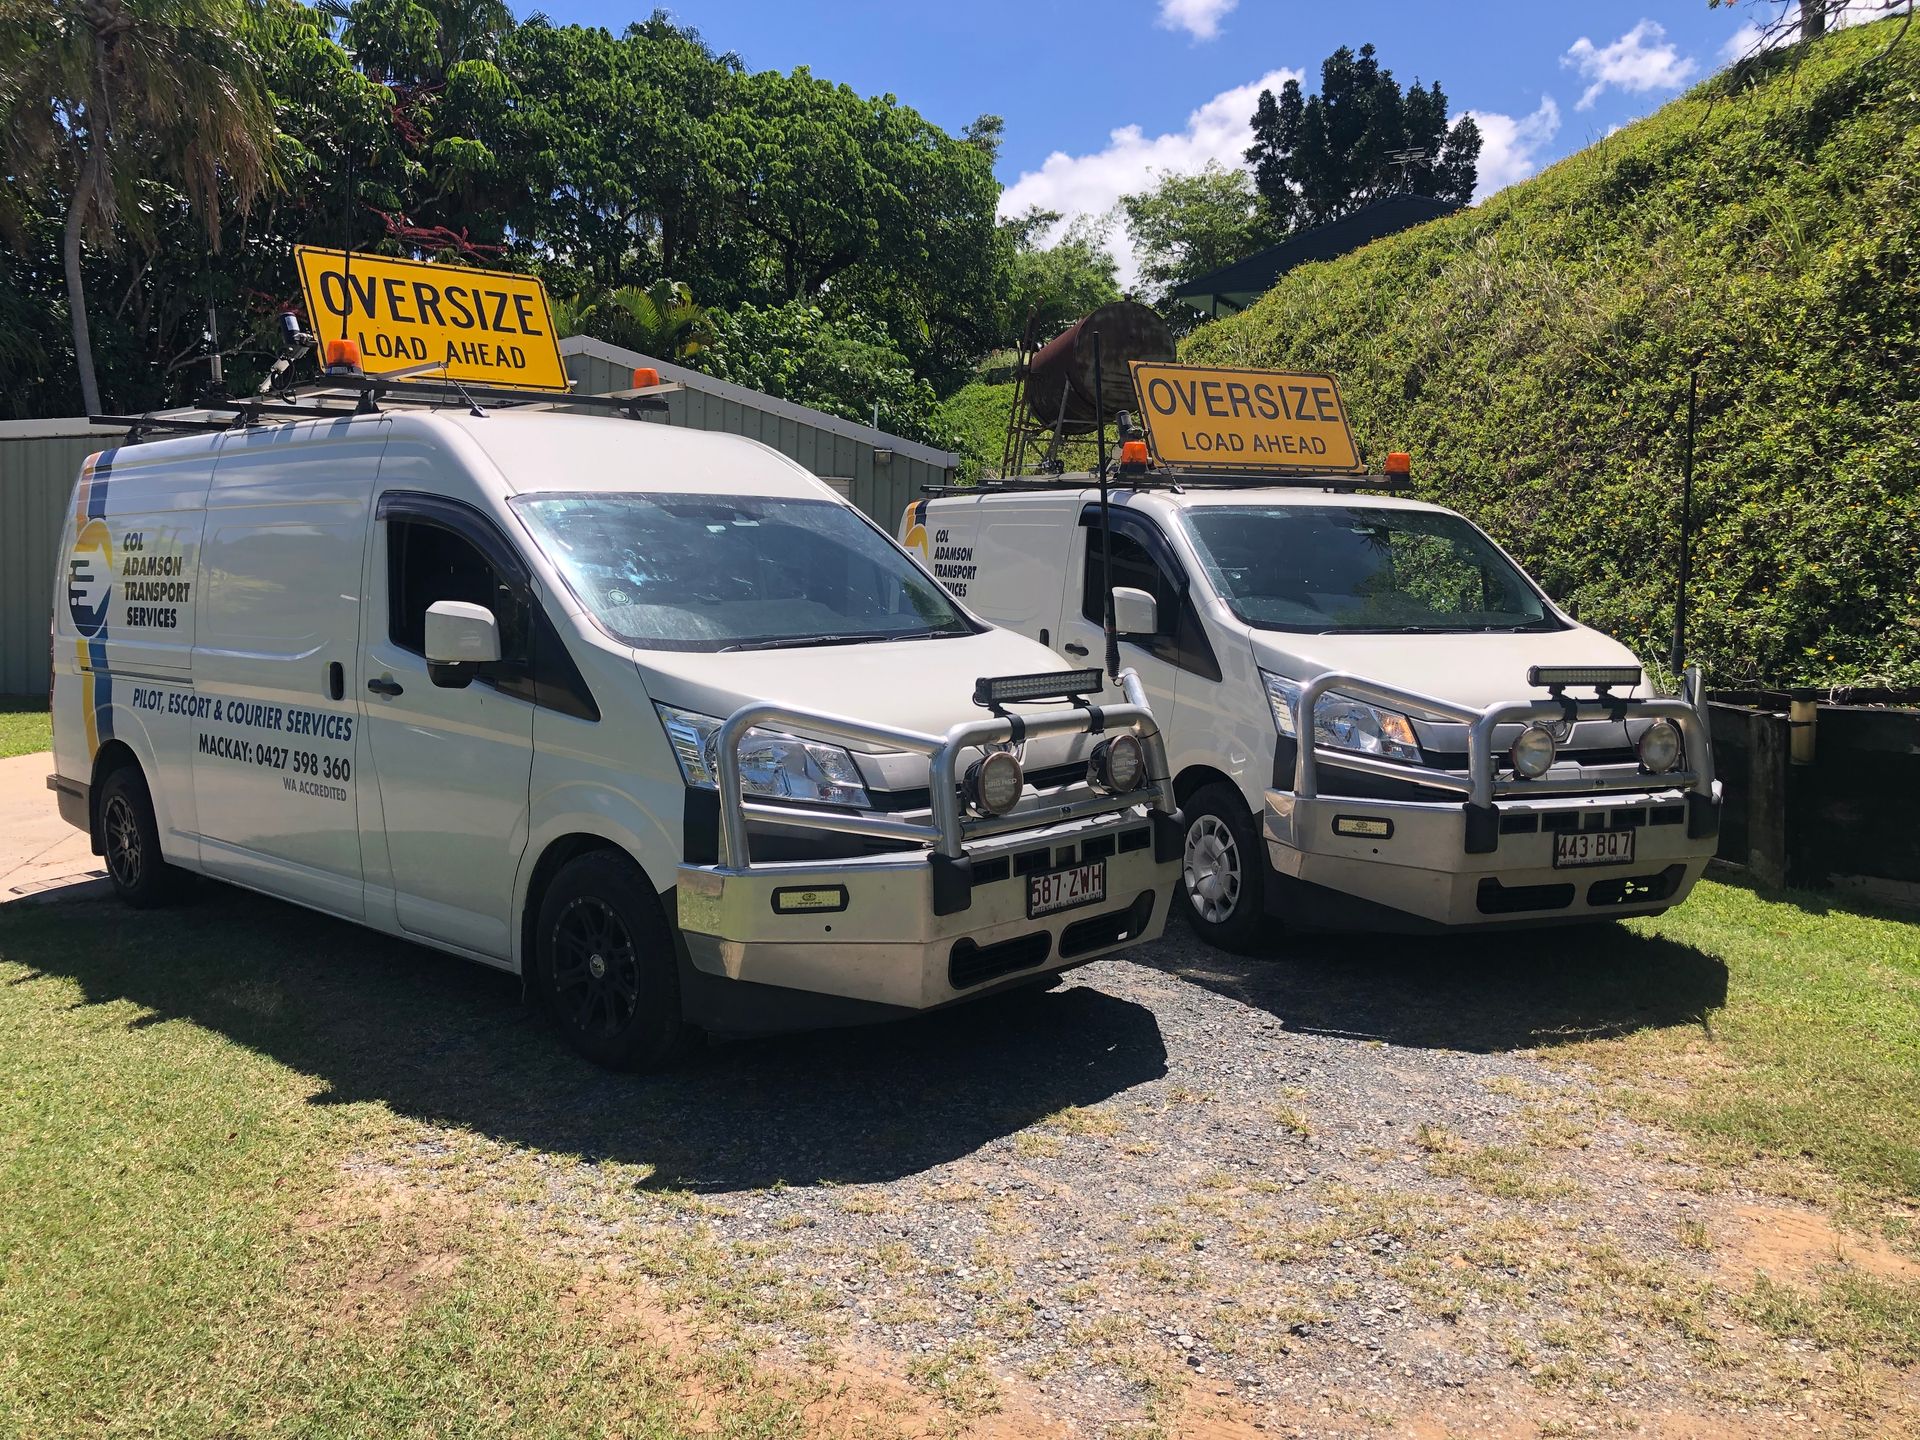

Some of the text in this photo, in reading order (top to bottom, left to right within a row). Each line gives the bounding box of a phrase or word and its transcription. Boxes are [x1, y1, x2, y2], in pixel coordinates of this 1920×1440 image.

[319, 271, 543, 337] OVERSIZE
[359, 332, 526, 369] LOAD AHEAD
[1148, 378, 1340, 422] OVERSIZE
[1182, 431, 1327, 455] LOAD AHEAD
[123, 532, 144, 551] COL
[936, 529, 949, 543] COL
[934, 546, 973, 562] ADAMSON
[122, 556, 182, 576] ADAMSON
[934, 564, 978, 580] TRANSPORT
[124, 581, 191, 602] TRANSPORT
[126, 606, 177, 629] SERVICES
[132, 687, 353, 742] PILOT, ESCORT & COURIER SERVICES
[198, 733, 351, 782] MACKAY: 0427 598 360
[283, 776, 347, 802] WA ACCREDITED
